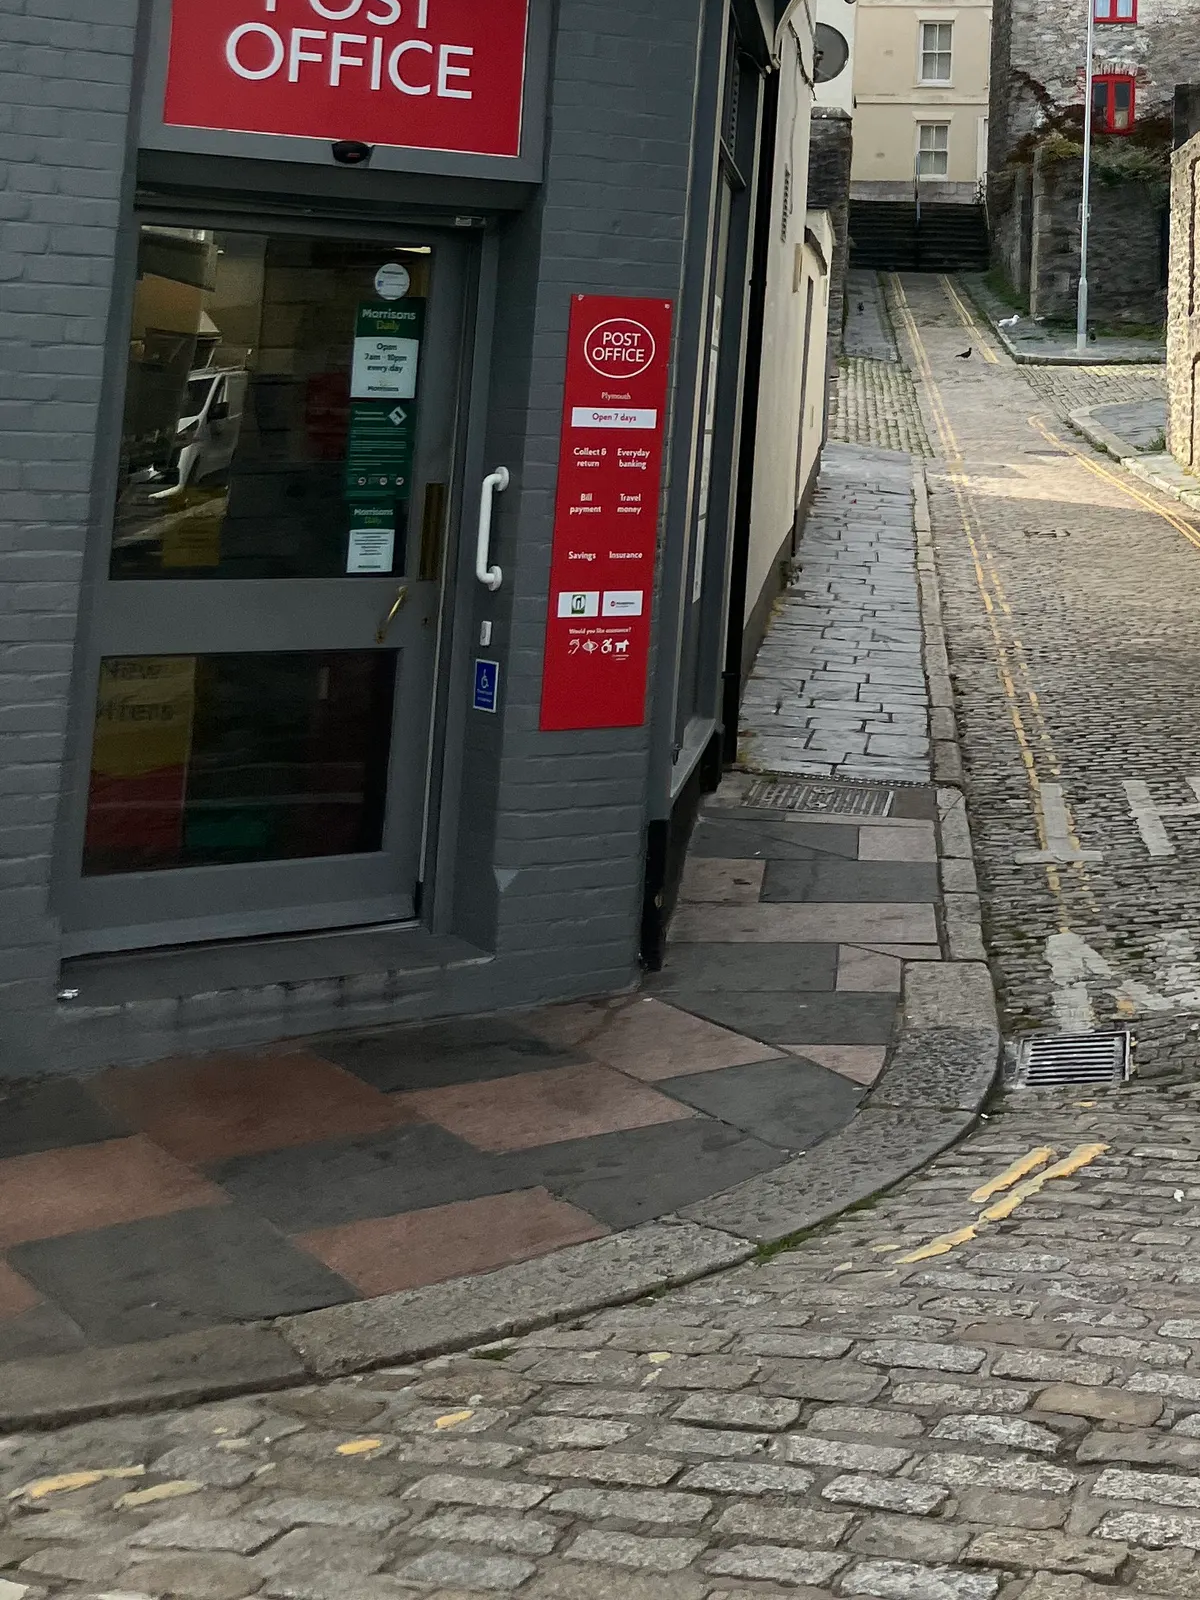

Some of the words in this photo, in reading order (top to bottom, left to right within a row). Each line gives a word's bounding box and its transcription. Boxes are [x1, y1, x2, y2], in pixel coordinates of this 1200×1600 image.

[225, 21, 474, 100] OFFICE
[361, 308, 416, 321] Morrisons
[376, 320, 400, 333] Daily
[603, 331, 641, 346] POST
[376, 342, 397, 352] Open
[364, 353, 381, 361] 7am
[387, 353, 407, 363] 10pm
[592, 347, 645, 362] OFFICE
[367, 364, 387, 374] every
[389, 363, 404, 374] day
[601, 391, 631, 401] Plymouth
[592, 412, 612, 423] Open
[614, 413, 619, 421] 7
[620, 413, 637, 424] days
[573, 447, 600, 456] Collect
[601, 448, 607, 456] &
[617, 448, 650, 458] Everyday
[619, 460, 647, 470] banking
[580, 493, 593, 502] Bill
[620, 493, 641, 502] Travel
[569, 506, 601, 515] payment
[617, 506, 642, 515] money
[568, 551, 596, 561] Savings
[609, 551, 643, 559] Insurance
